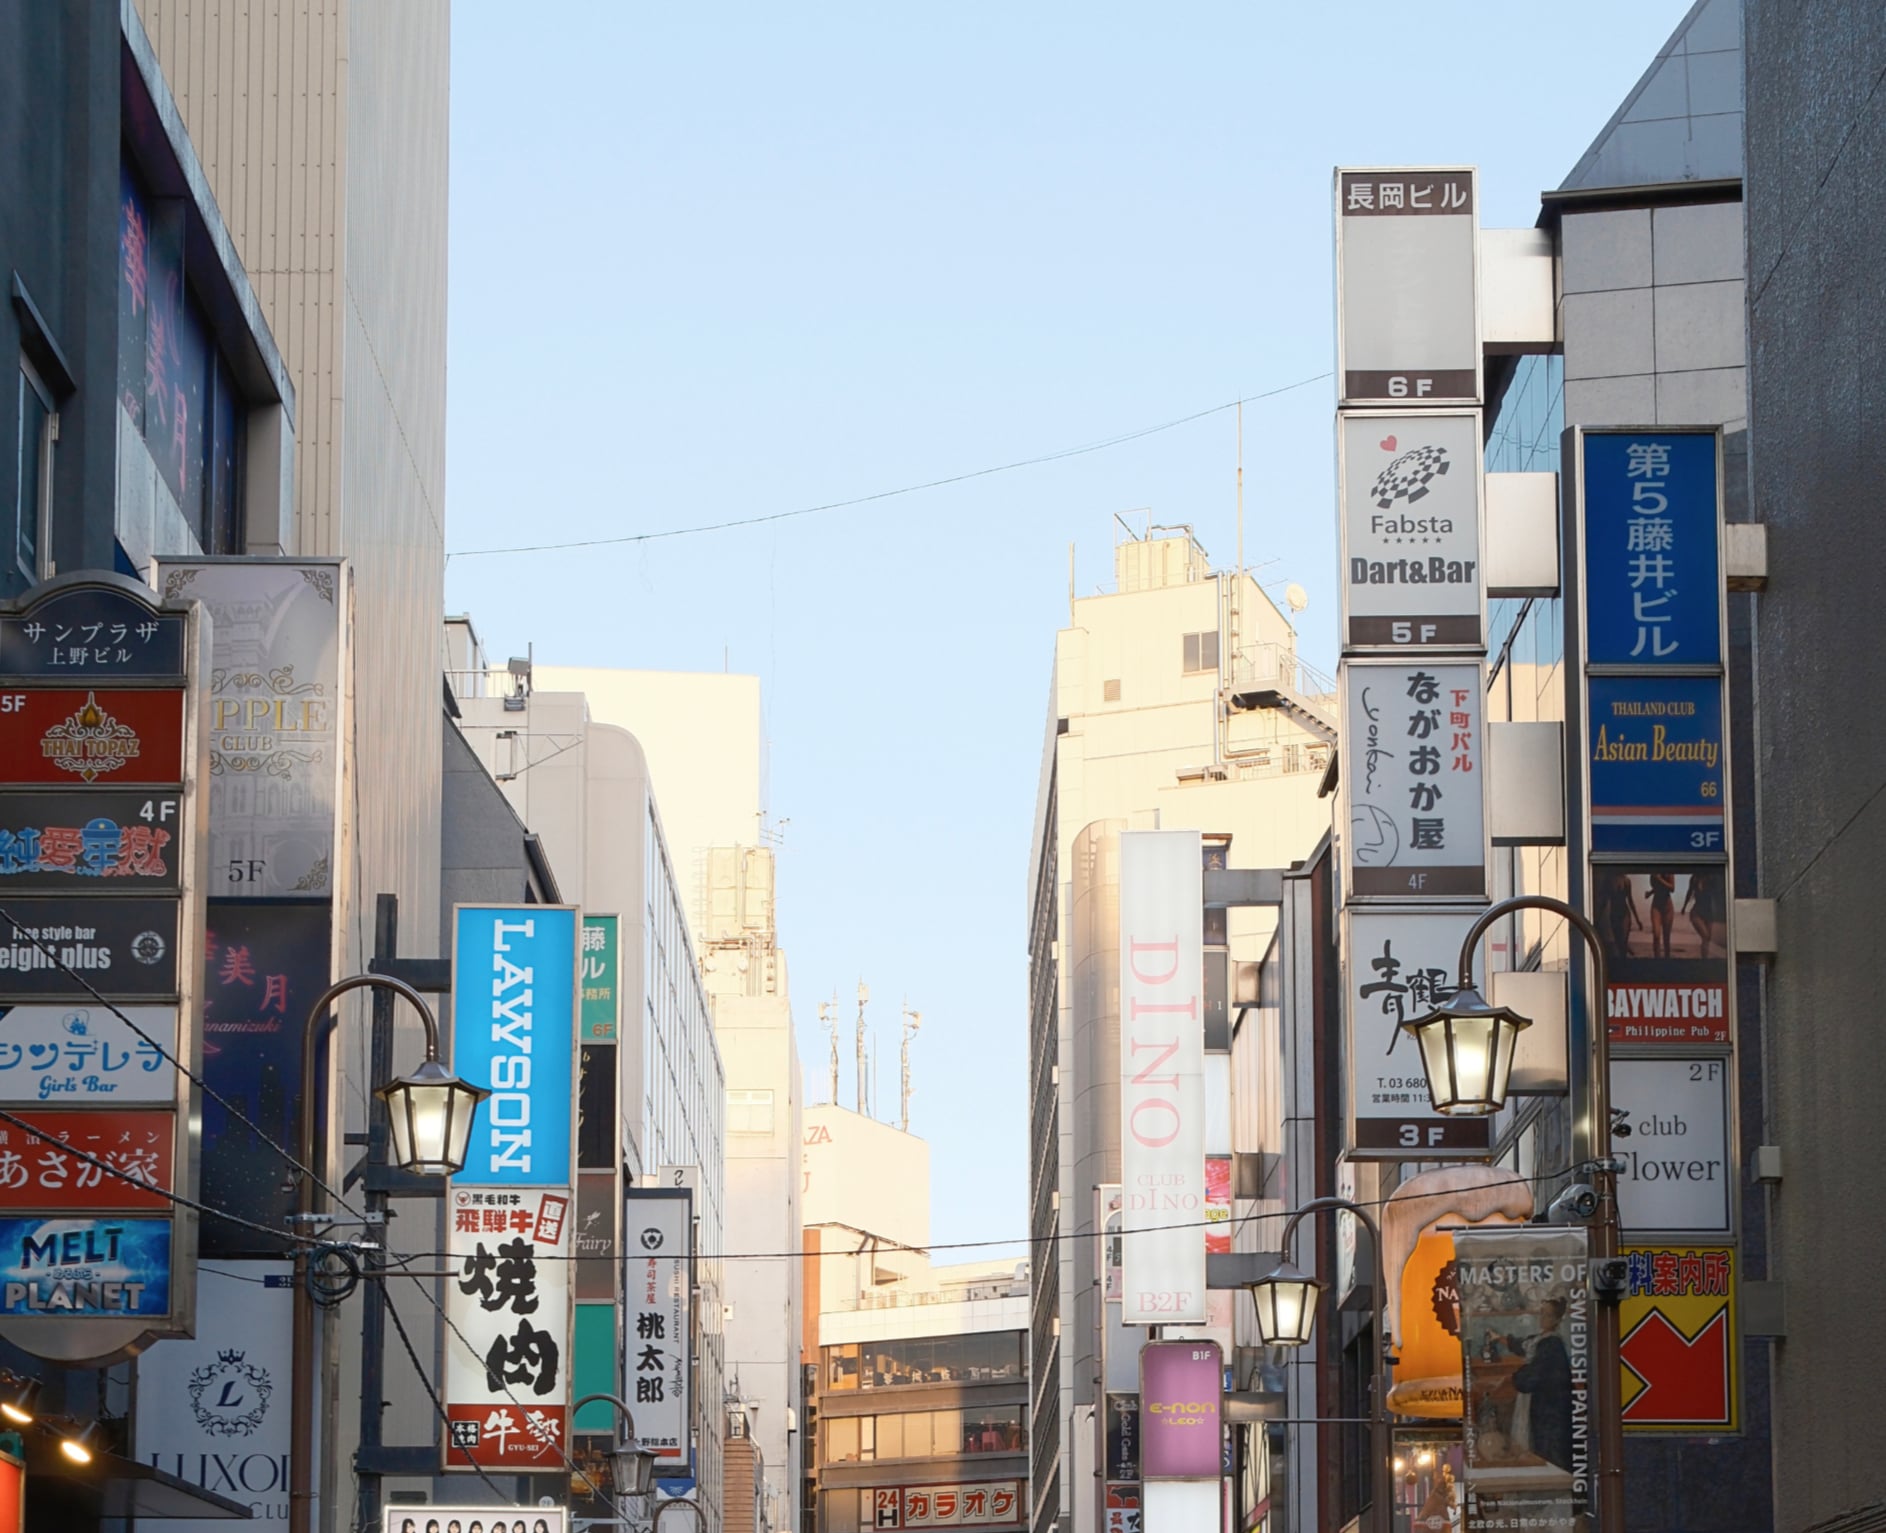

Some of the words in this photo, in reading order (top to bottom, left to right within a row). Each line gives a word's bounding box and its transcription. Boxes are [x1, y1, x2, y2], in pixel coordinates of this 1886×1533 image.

[1347, 183, 1467, 211] 長岡ビル
[1387, 376, 1433, 397] 6F
[1370, 514, 1454, 535] Fabsta
[1626, 443, 1679, 657] 第5藤井ビル
[1350, 556, 1476, 585] Dart&Bar
[23, 621, 160, 644] サンプラザ
[1391, 621, 1437, 643] 5F
[47, 647, 133, 666] 上野ビル
[0, 694, 26, 713] 5F
[1611, 701, 1666, 716] THAILAND
[1667, 701, 1695, 716] CLUB
[212, 699, 328, 732] PPLE
[1449, 689, 1473, 773] 下町バル
[41, 738, 83, 758] THAI
[85, 738, 140, 758] TOPAZ
[220, 735, 273, 752] CLUB
[1593, 726, 1648, 762] Asian
[1652, 723, 1719, 768] Beauty
[1406, 671, 1445, 851] ながおか屋
[1700, 782, 1717, 798] 66
[139, 801, 177, 822] 4F
[1690, 831, 1720, 848] 3F
[227, 859, 266, 882] 5F
[1407, 873, 1426, 890] 4F
[42, 925, 73, 942] style
[75, 925, 97, 940] bar
[582, 926, 606, 951] 藤
[60, 943, 112, 972] plus
[582, 957, 606, 980] ル
[1608, 987, 1724, 1018] BAYWATCH
[202, 1015, 283, 1034] anamizuki
[1625, 1024, 1688, 1038] Philippine
[1690, 1024, 1710, 1037] Pub
[489, 918, 535, 1173] LAWSON
[1130, 934, 1198, 1149] DINO
[1688, 1062, 1720, 1082] 2F
[38, 1075, 77, 1100] Girl's
[81, 1075, 118, 1093] Bar
[1398, 1124, 1444, 1147] 3F
[1638, 1114, 1687, 1137] club
[0, 1148, 159, 1190] あさが家
[1612, 1150, 1721, 1182] Flower
[1136, 1173, 1185, 1187] CLUB
[471, 1193, 521, 1206] 黒毛和牛
[1129, 1188, 1199, 1211] DINO
[455, 1209, 534, 1234] 飛騨牛
[537, 1199, 566, 1240] 直送
[20, 1227, 123, 1270] MELT
[574, 1232, 613, 1256] Fairy
[1459, 1265, 1555, 1286] MASTERS
[1560, 1264, 1586, 1283] OF
[1627, 1251, 1730, 1296] 料案内所
[6, 1282, 146, 1311] PLANET
[1137, 1291, 1193, 1313] B2F
[458, 1236, 560, 1397] 焼肉
[1569, 1287, 1587, 1384] SWEDISH
[635, 1312, 665, 1403] 桃太郎
[1192, 1351, 1211, 1361] B1F
[1571, 1388, 1588, 1493] PAINTING
[248, 1501, 290, 1520] CLU
[877, 1490, 898, 1508] 24
[905, 1487, 1016, 1521] カラオケ
[877, 1509, 898, 1528] H
